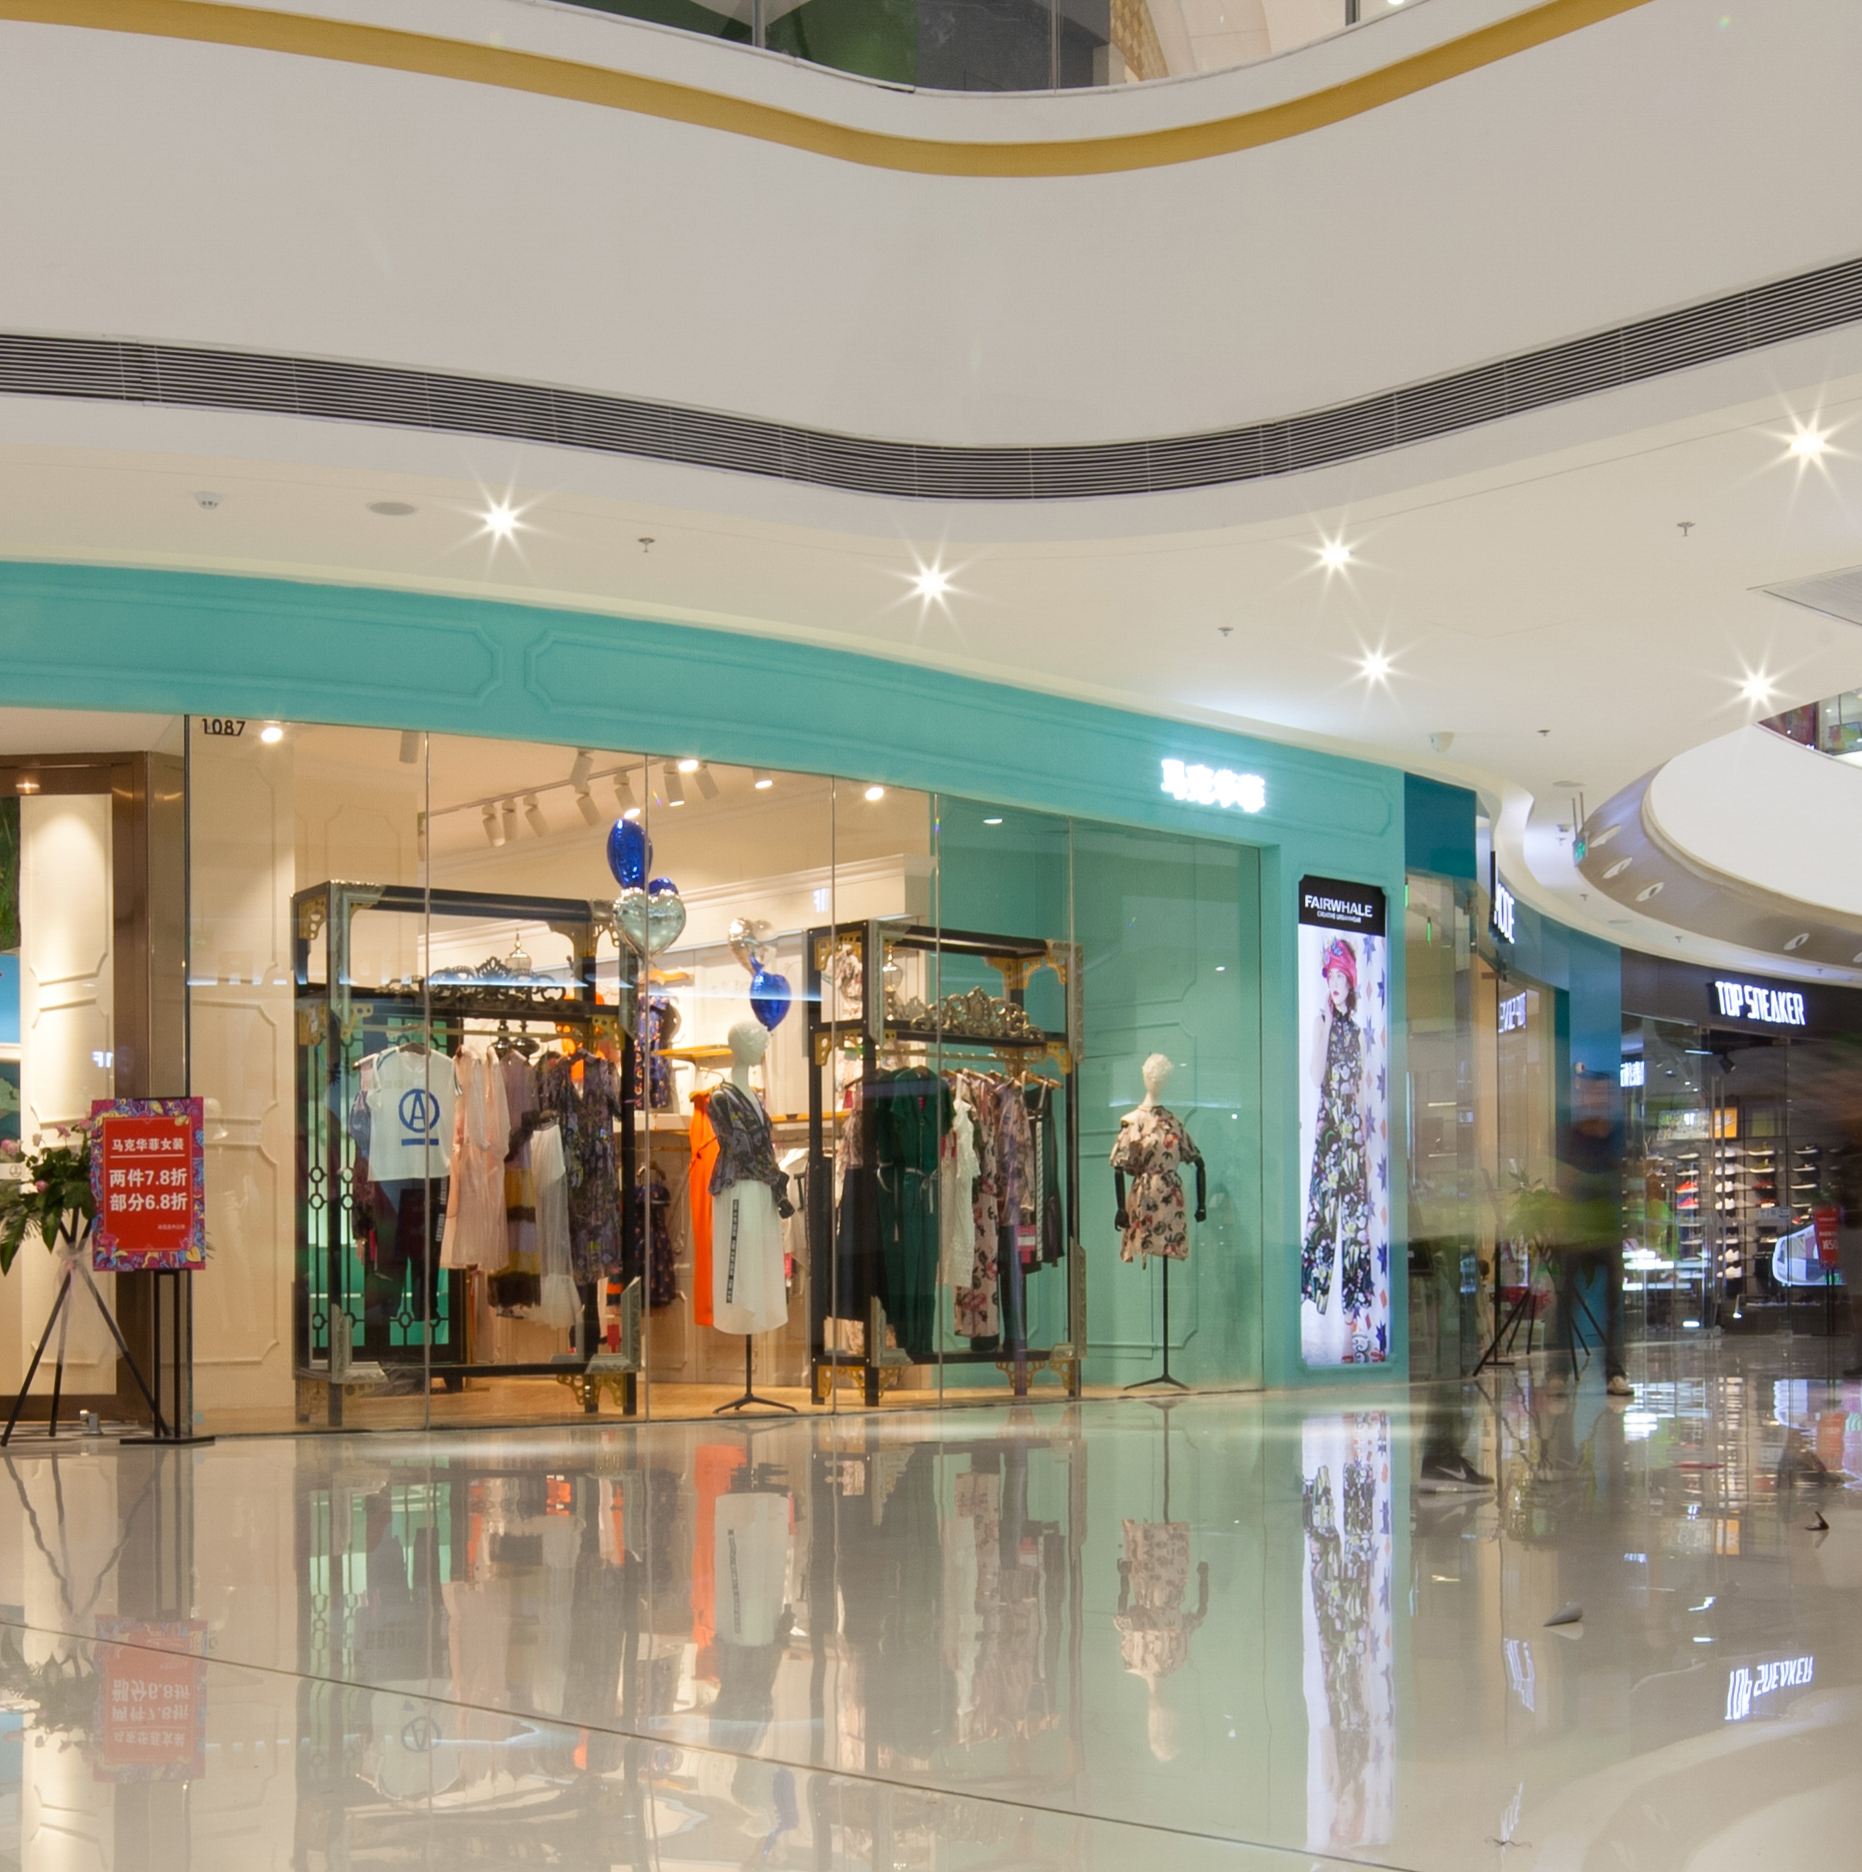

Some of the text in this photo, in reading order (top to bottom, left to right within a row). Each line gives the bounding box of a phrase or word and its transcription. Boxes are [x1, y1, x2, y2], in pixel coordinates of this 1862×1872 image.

[202, 718, 246, 736] 1087
[1305, 894, 1373, 918] FAIRWHALE
[1715, 981, 1744, 1016] TOP
[112, 1138, 184, 1152] 马克华菲女装
[109, 1169, 187, 1188] 两件7.8折
[110, 1193, 187, 1212] 部分6.8折
